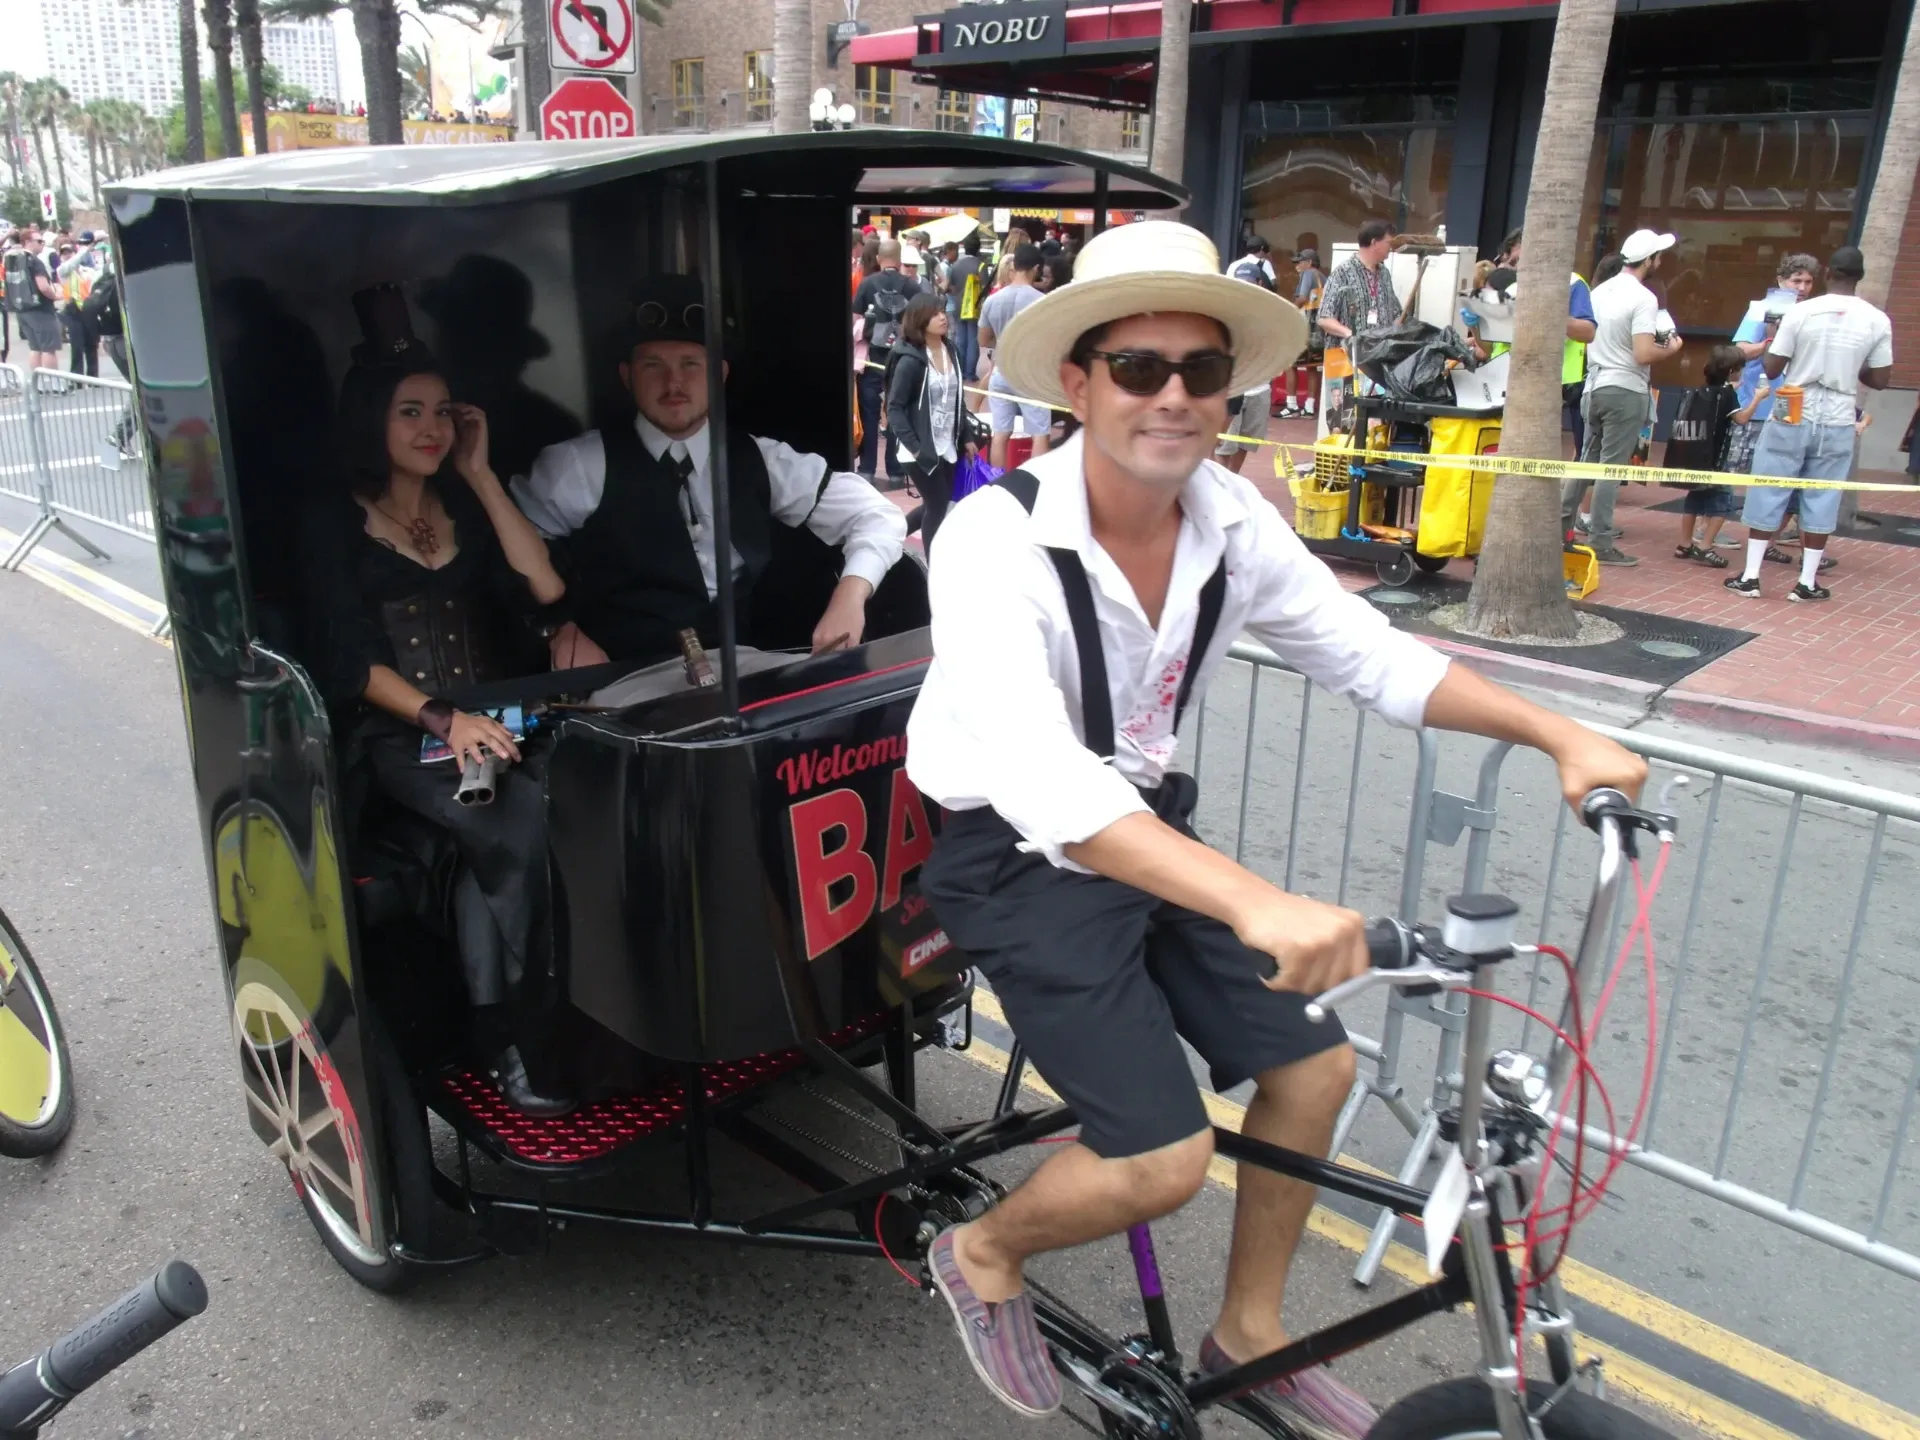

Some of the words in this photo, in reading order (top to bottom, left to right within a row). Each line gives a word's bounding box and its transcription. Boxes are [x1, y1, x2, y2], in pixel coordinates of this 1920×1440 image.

[954, 15, 1050, 47] NOBU
[299, 121, 332, 130] SHIFTY
[309, 130, 332, 139] LOOK
[336, 123, 369, 141] FRE
[550, 110, 629, 141] STOP
[1510, 460, 1520, 472] DO
[1522, 461, 1538, 473] NOT
[1540, 462, 1566, 475] CROSS
[789, 767, 945, 961] BA
